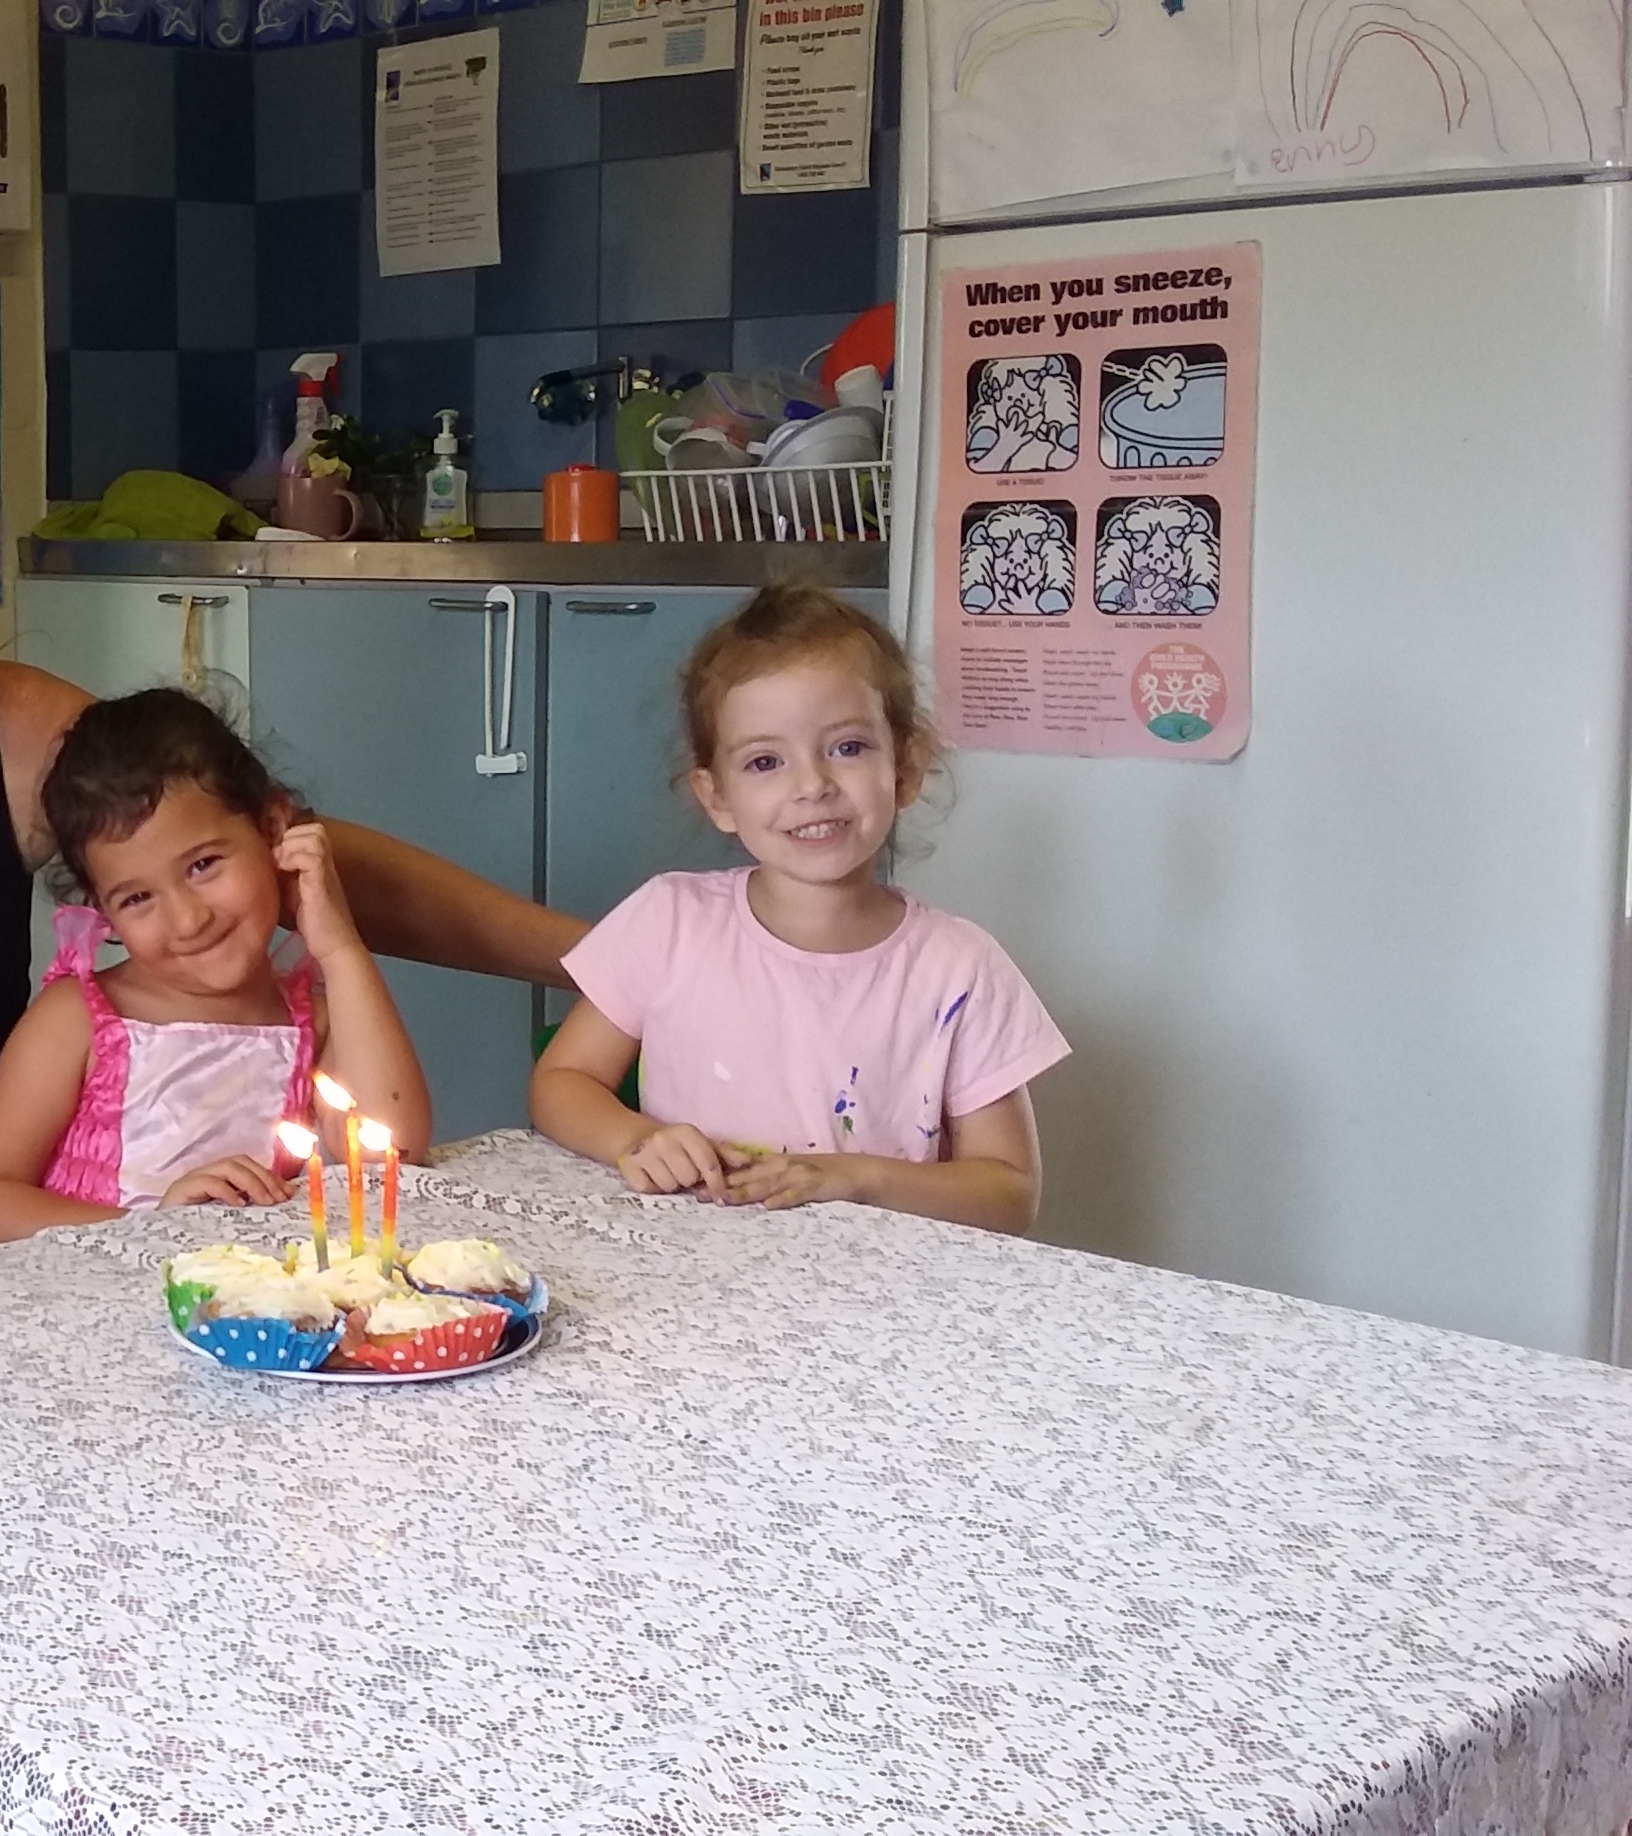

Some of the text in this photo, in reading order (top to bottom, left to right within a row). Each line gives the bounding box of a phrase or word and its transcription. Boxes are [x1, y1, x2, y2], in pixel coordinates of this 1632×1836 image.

[776, 10, 798, 25] this
[803, 8, 822, 22] bin
[825, 4, 864, 22] please
[966, 265, 1233, 306] When you sneeze,
[968, 296, 1229, 338] cover your mouth
